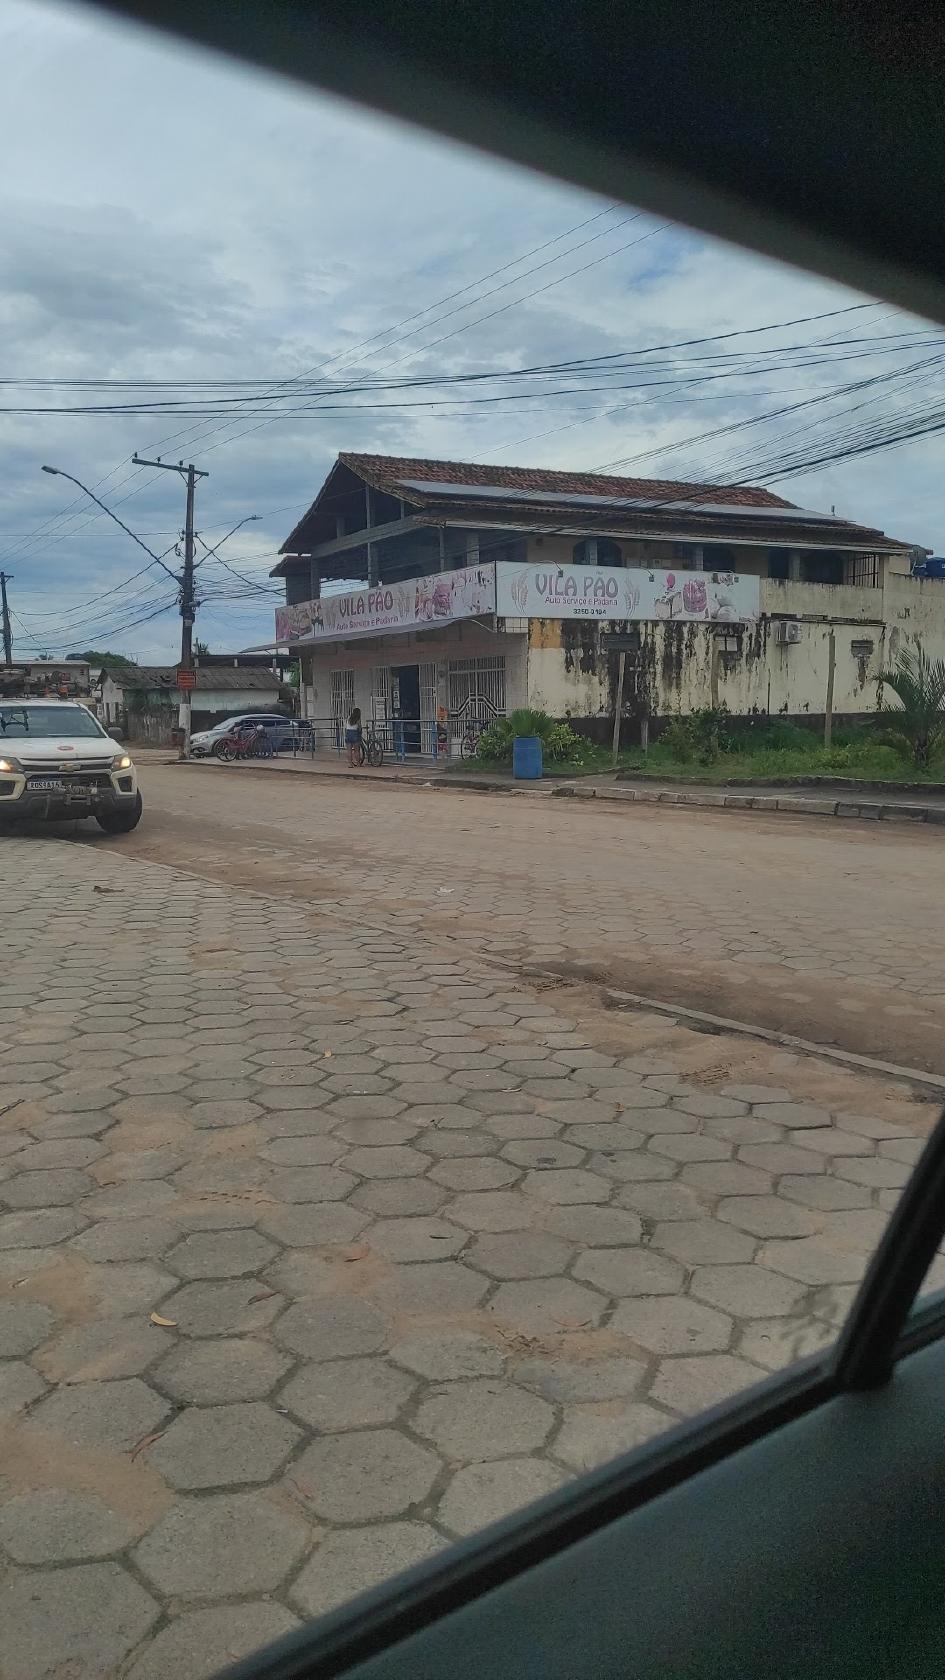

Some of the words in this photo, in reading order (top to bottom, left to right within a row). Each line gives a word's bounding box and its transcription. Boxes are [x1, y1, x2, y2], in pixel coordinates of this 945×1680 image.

[535, 573, 578, 597] VILA
[583, 571, 619, 598] PÃO
[339, 595, 365, 618] VILA
[544, 596, 561, 604] Auto
[563, 597, 587, 606] Serviço
[593, 598, 618, 606] Padaria
